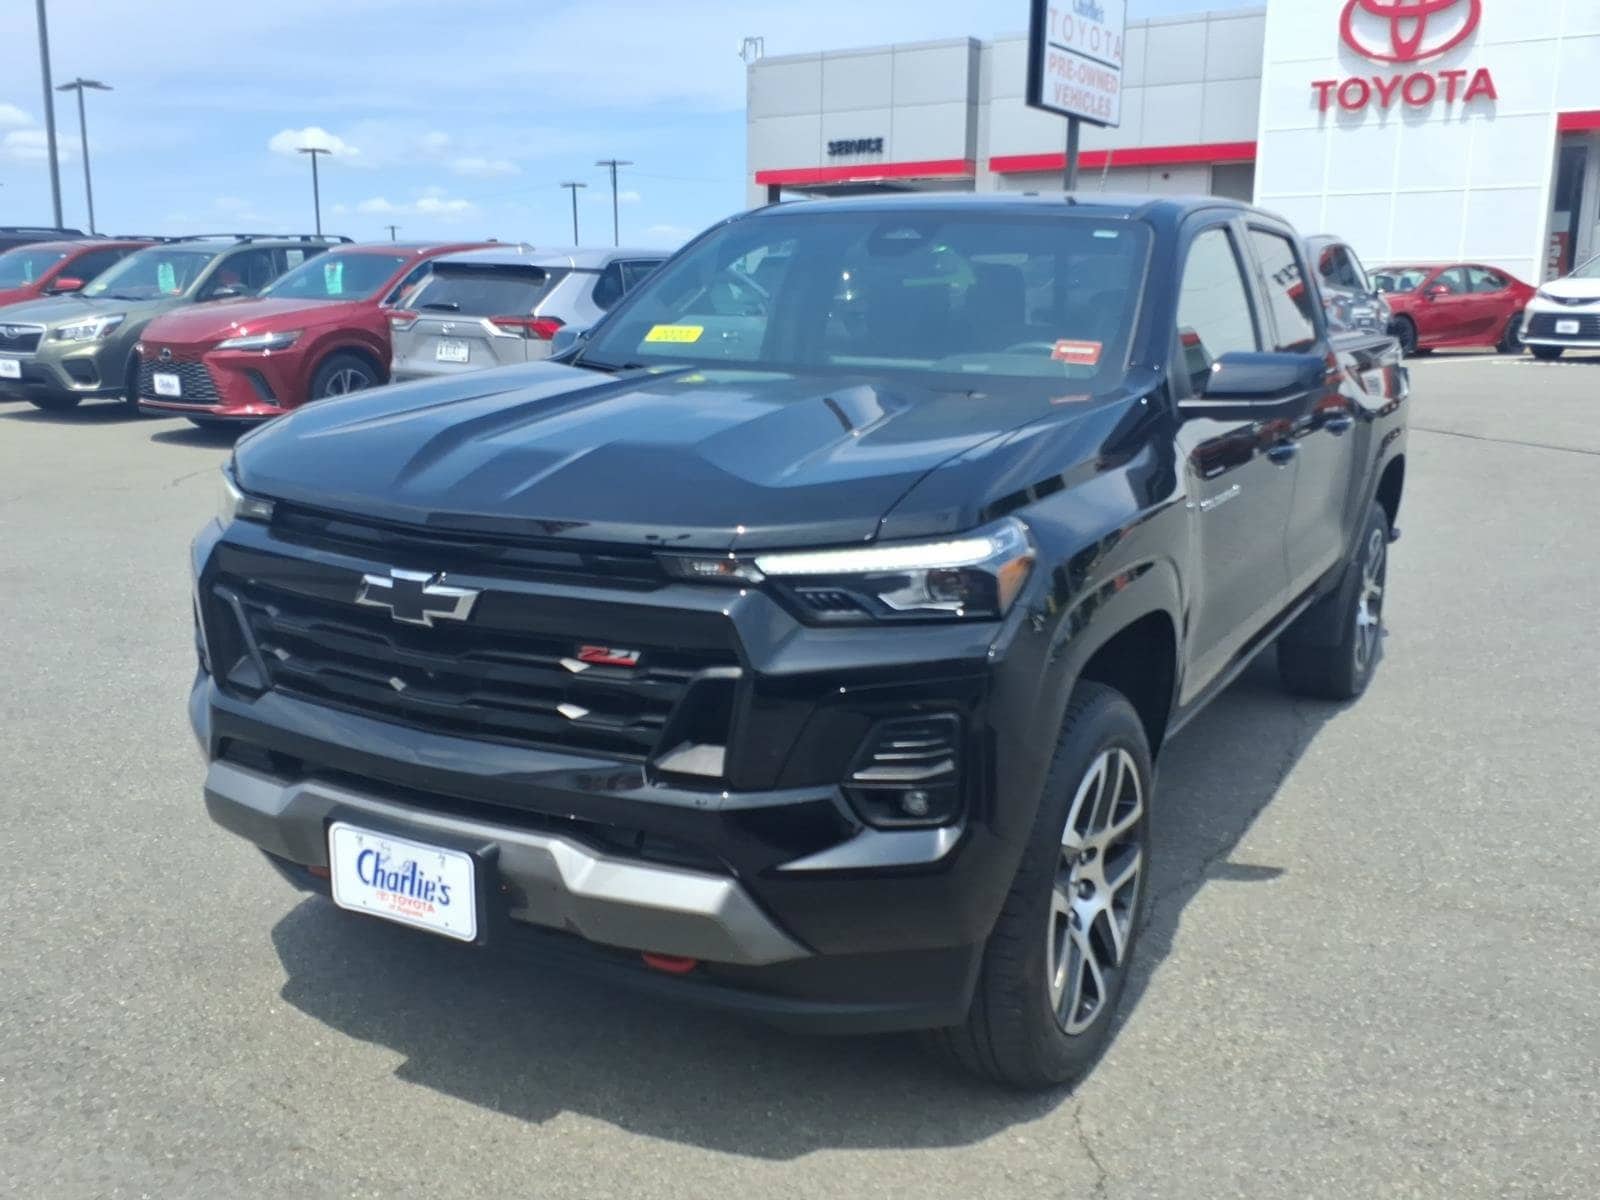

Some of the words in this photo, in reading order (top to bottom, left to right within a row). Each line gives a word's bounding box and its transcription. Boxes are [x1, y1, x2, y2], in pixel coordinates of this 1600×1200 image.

[1049, 8, 1120, 60] TOYOTA
[1047, 53, 1118, 94] PRE-OWNED
[1311, 68, 1497, 112] TOYOTA
[1054, 82, 1111, 117] VEHICLES
[828, 137, 883, 156] SERVICE
[357, 849, 451, 906] Charlie's
[392, 894, 435, 913] TOYOTA
